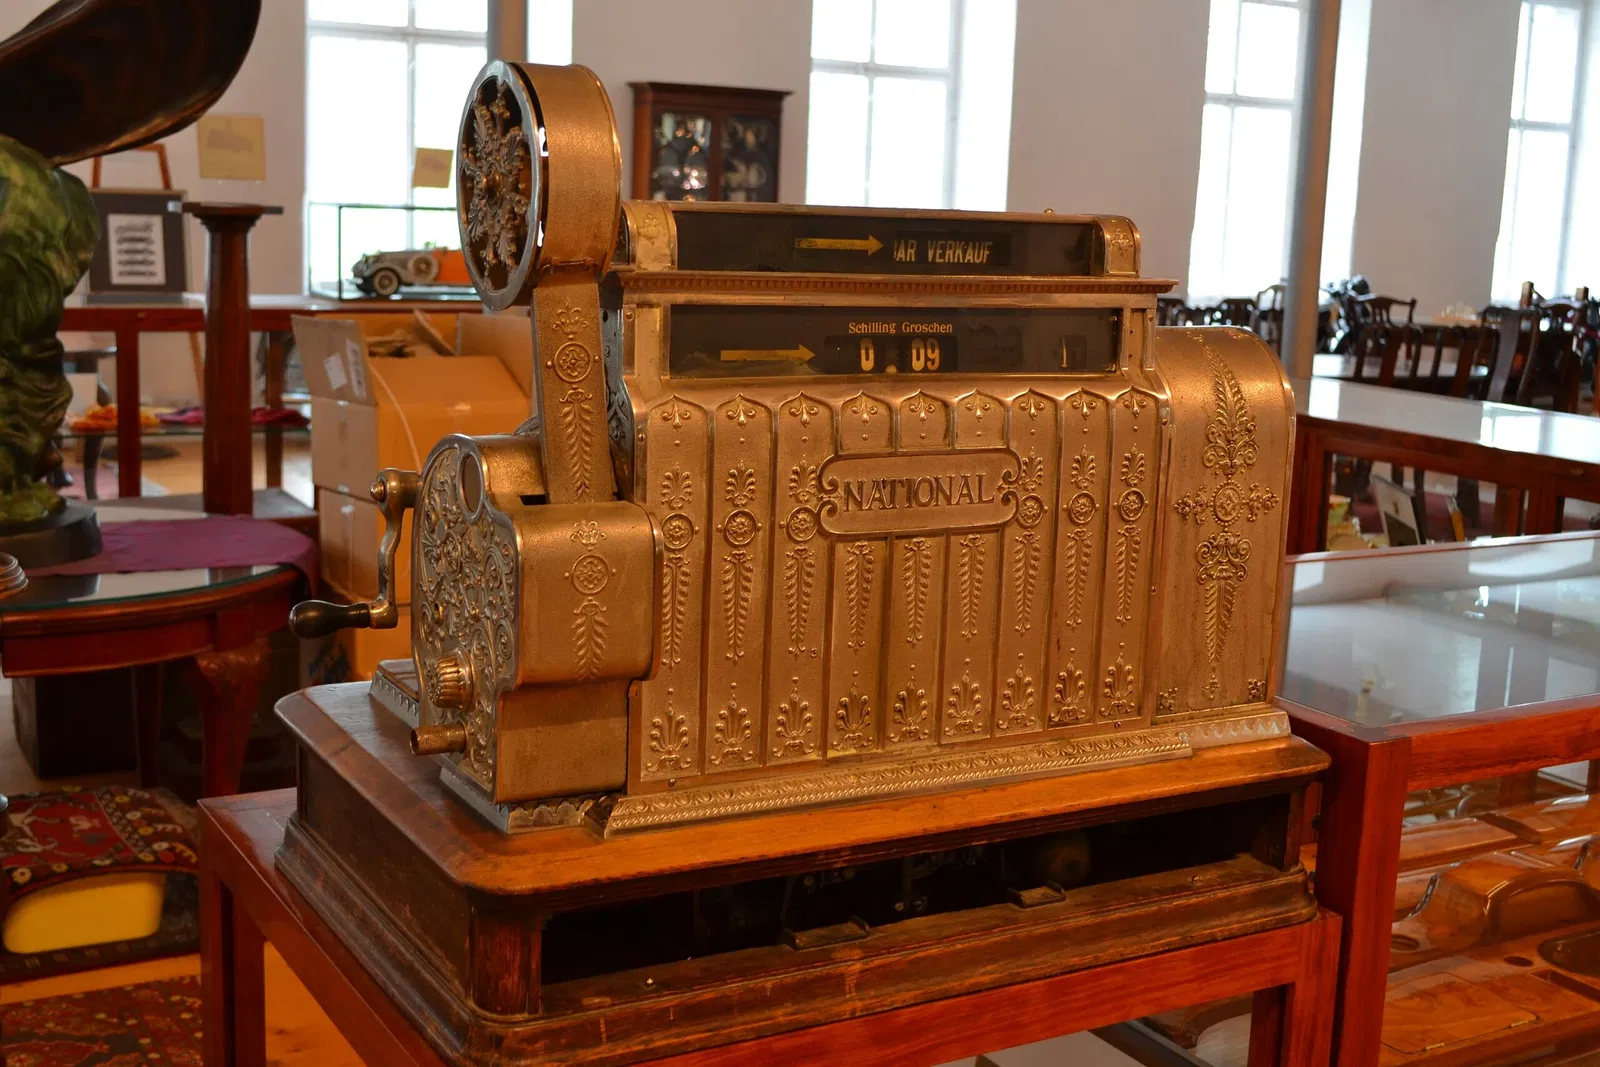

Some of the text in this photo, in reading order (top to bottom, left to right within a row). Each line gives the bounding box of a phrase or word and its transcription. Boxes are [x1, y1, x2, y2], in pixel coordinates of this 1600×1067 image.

[927, 239, 993, 264] VERKAUF
[848, 321, 953, 335] Schilling Groschen
[842, 472, 996, 513] NATIONAL
